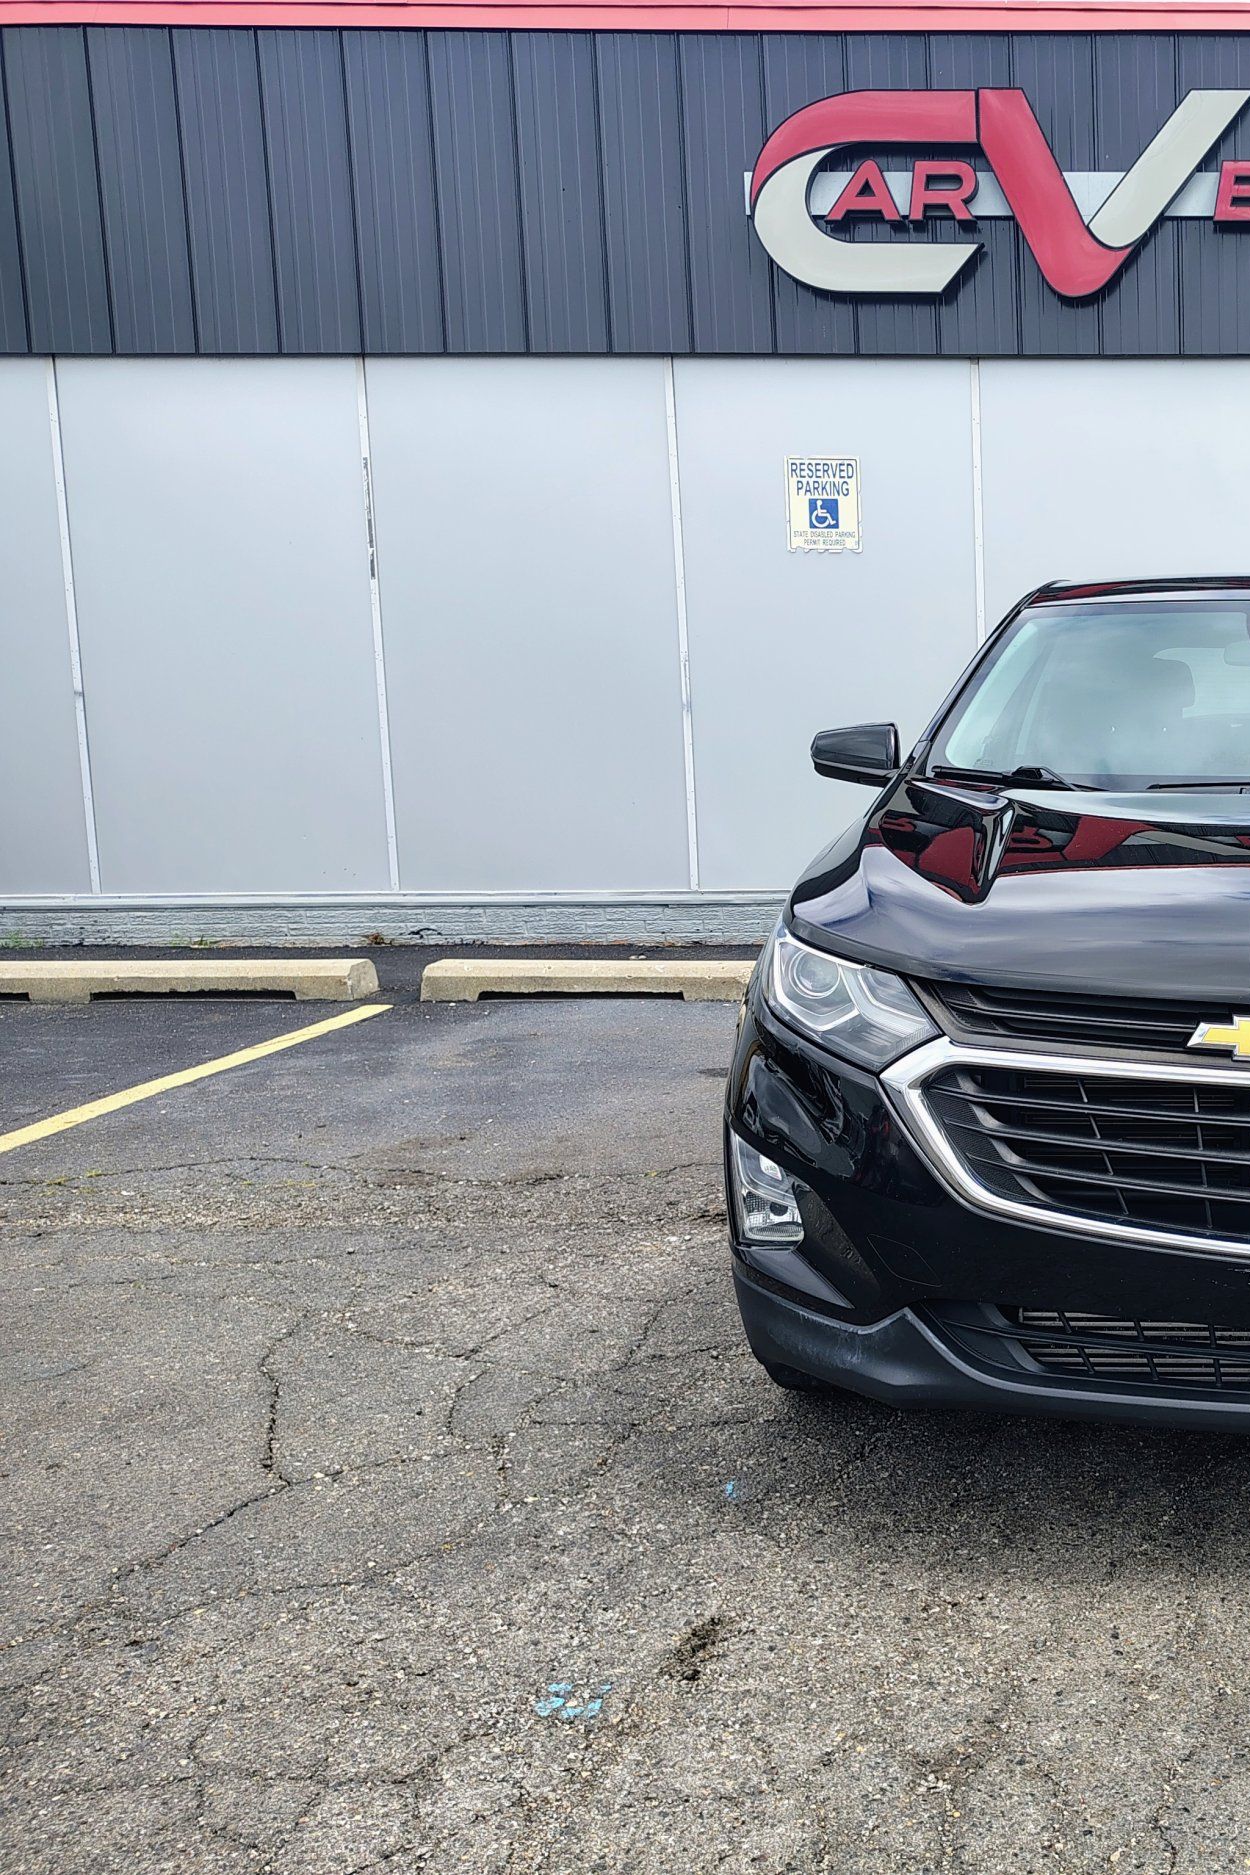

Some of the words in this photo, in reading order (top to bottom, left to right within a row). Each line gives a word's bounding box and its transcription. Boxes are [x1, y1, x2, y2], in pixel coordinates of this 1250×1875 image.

[790, 462, 854, 479] RESERVED
[796, 480, 850, 497] PARKING
[793, 530, 809, 538] STATE
[810, 530, 834, 539] DISABLED
[835, 531, 856, 539] PARKING
[822, 539, 846, 547] REQUIRED
